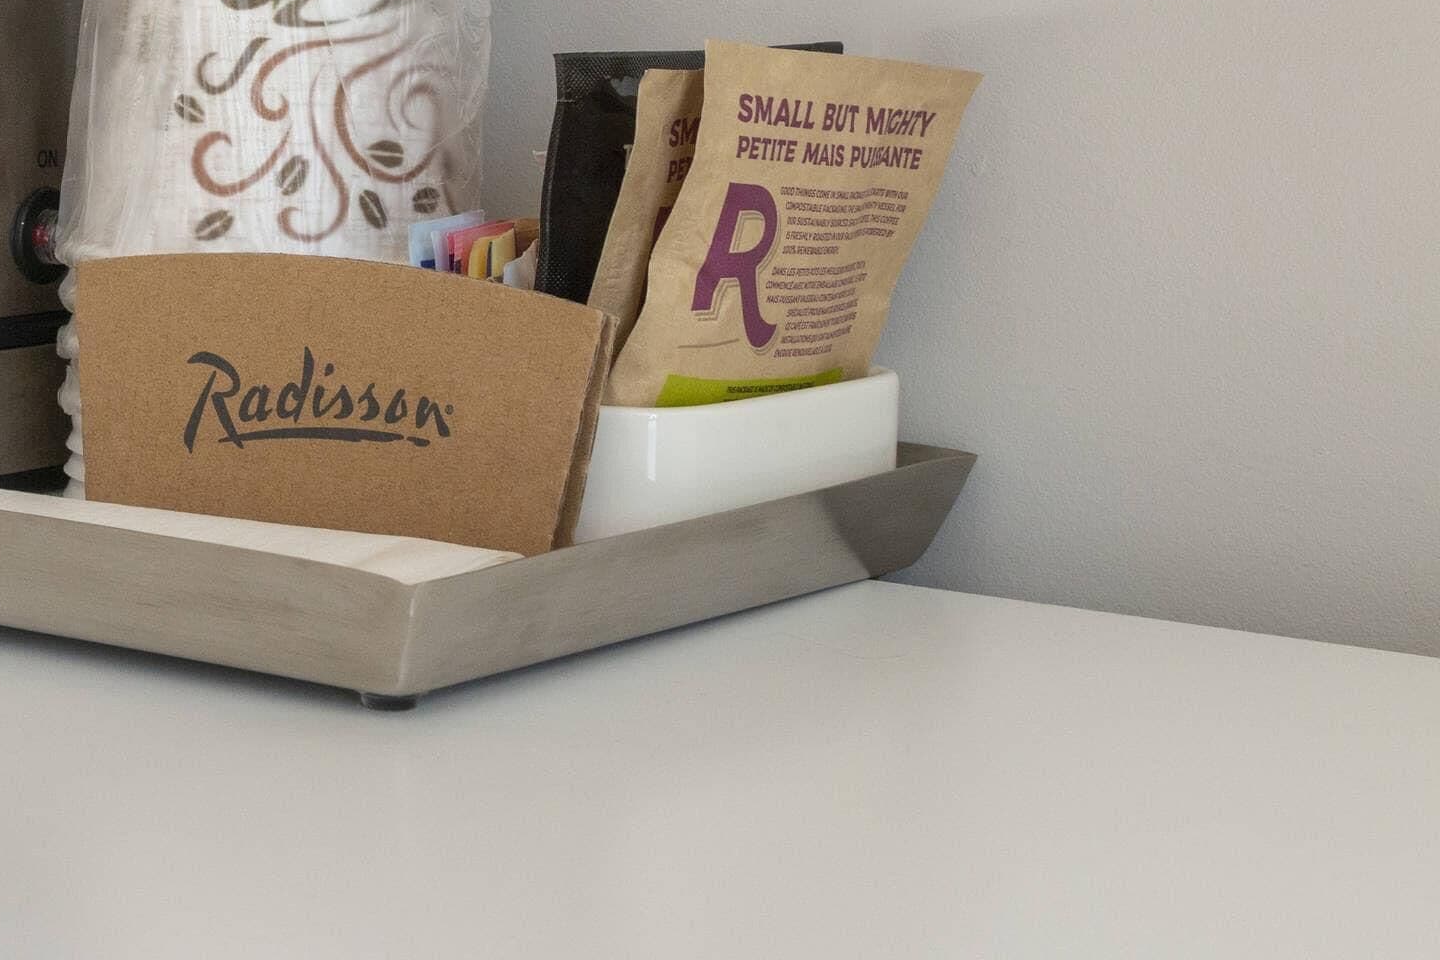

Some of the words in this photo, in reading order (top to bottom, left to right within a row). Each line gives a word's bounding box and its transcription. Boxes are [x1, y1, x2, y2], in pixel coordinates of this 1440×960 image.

[737, 93, 815, 130] SMALL
[821, 103, 859, 133] BUT
[865, 106, 936, 138] MIGHTY
[37, 149, 58, 168] ON
[736, 135, 798, 163] PETITE
[802, 142, 845, 167] MAIS
[184, 345, 450, 453] Radisson
